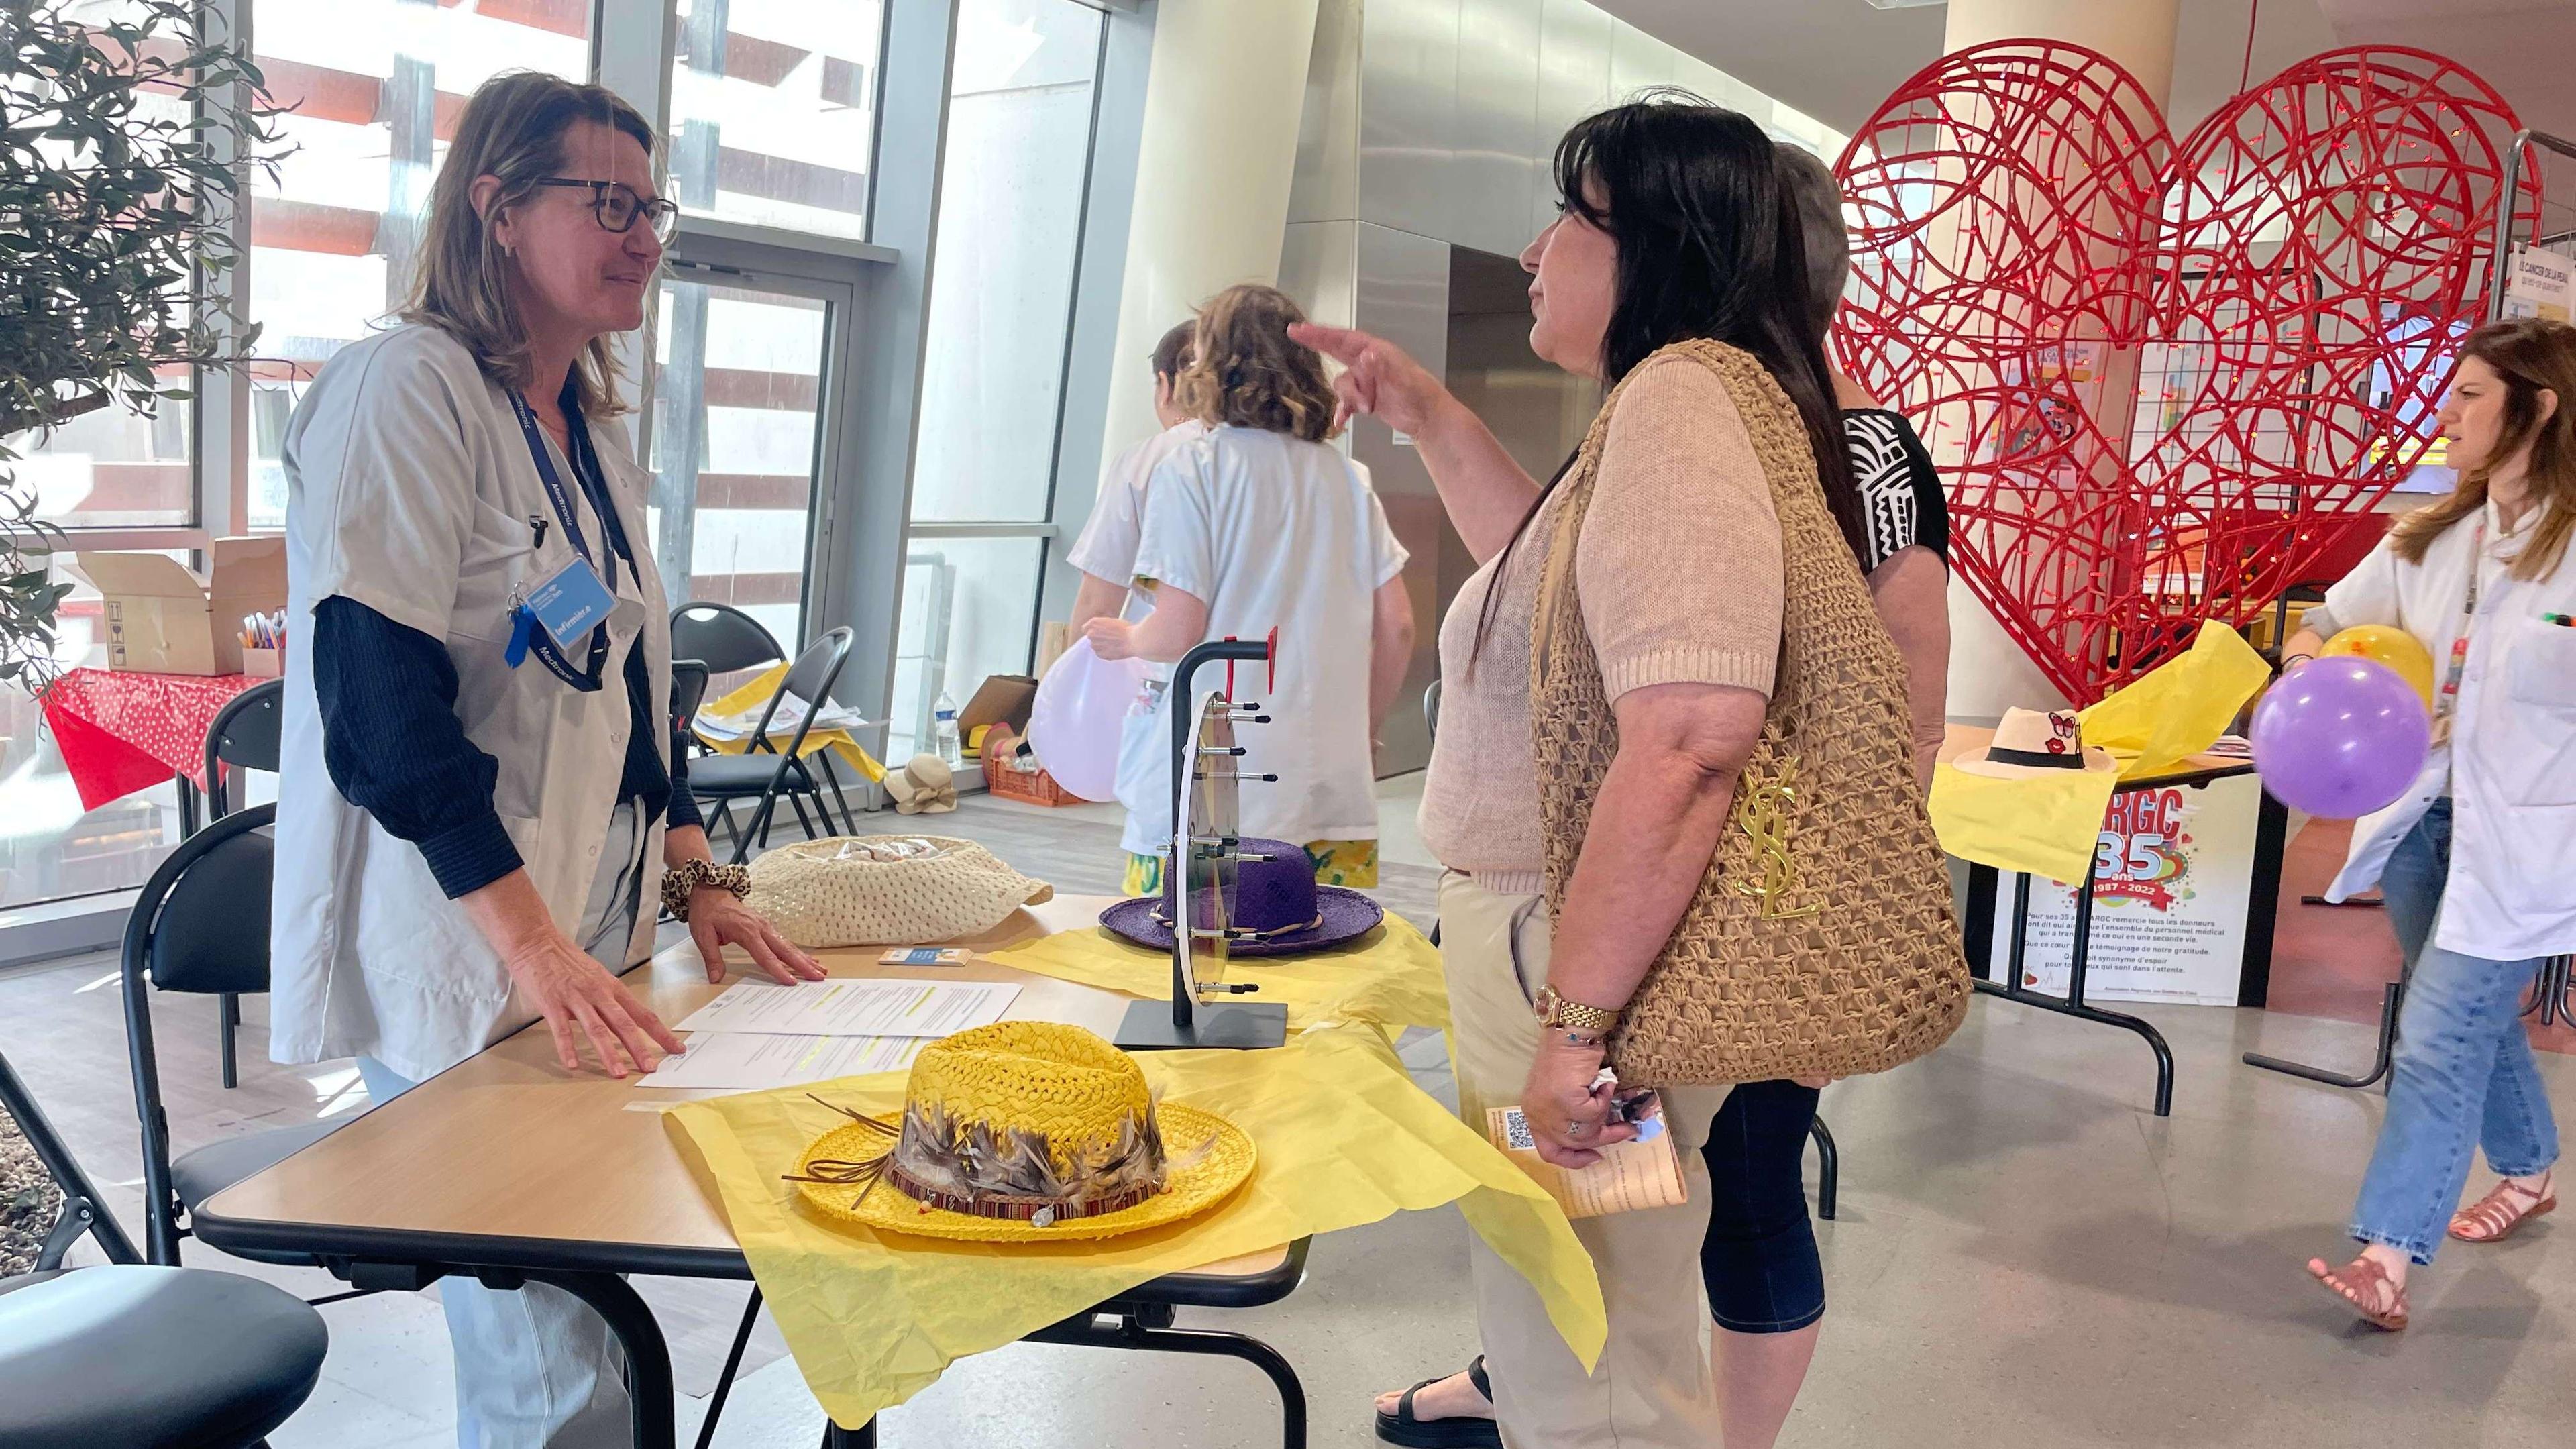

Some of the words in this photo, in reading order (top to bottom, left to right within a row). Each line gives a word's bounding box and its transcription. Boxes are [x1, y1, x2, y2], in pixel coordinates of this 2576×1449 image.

[551, 482, 573, 528] Medtronic
[539, 647, 575, 680] Medtronic
[2102, 788, 2183, 842] RGC
[2094, 830, 2164, 881] 35
[2112, 873, 2135, 881] ans
[2127, 883, 2156, 896] 2022
[2101, 924, 2143, 932] l'ensemble
[2096, 944, 2140, 953] témoignage
